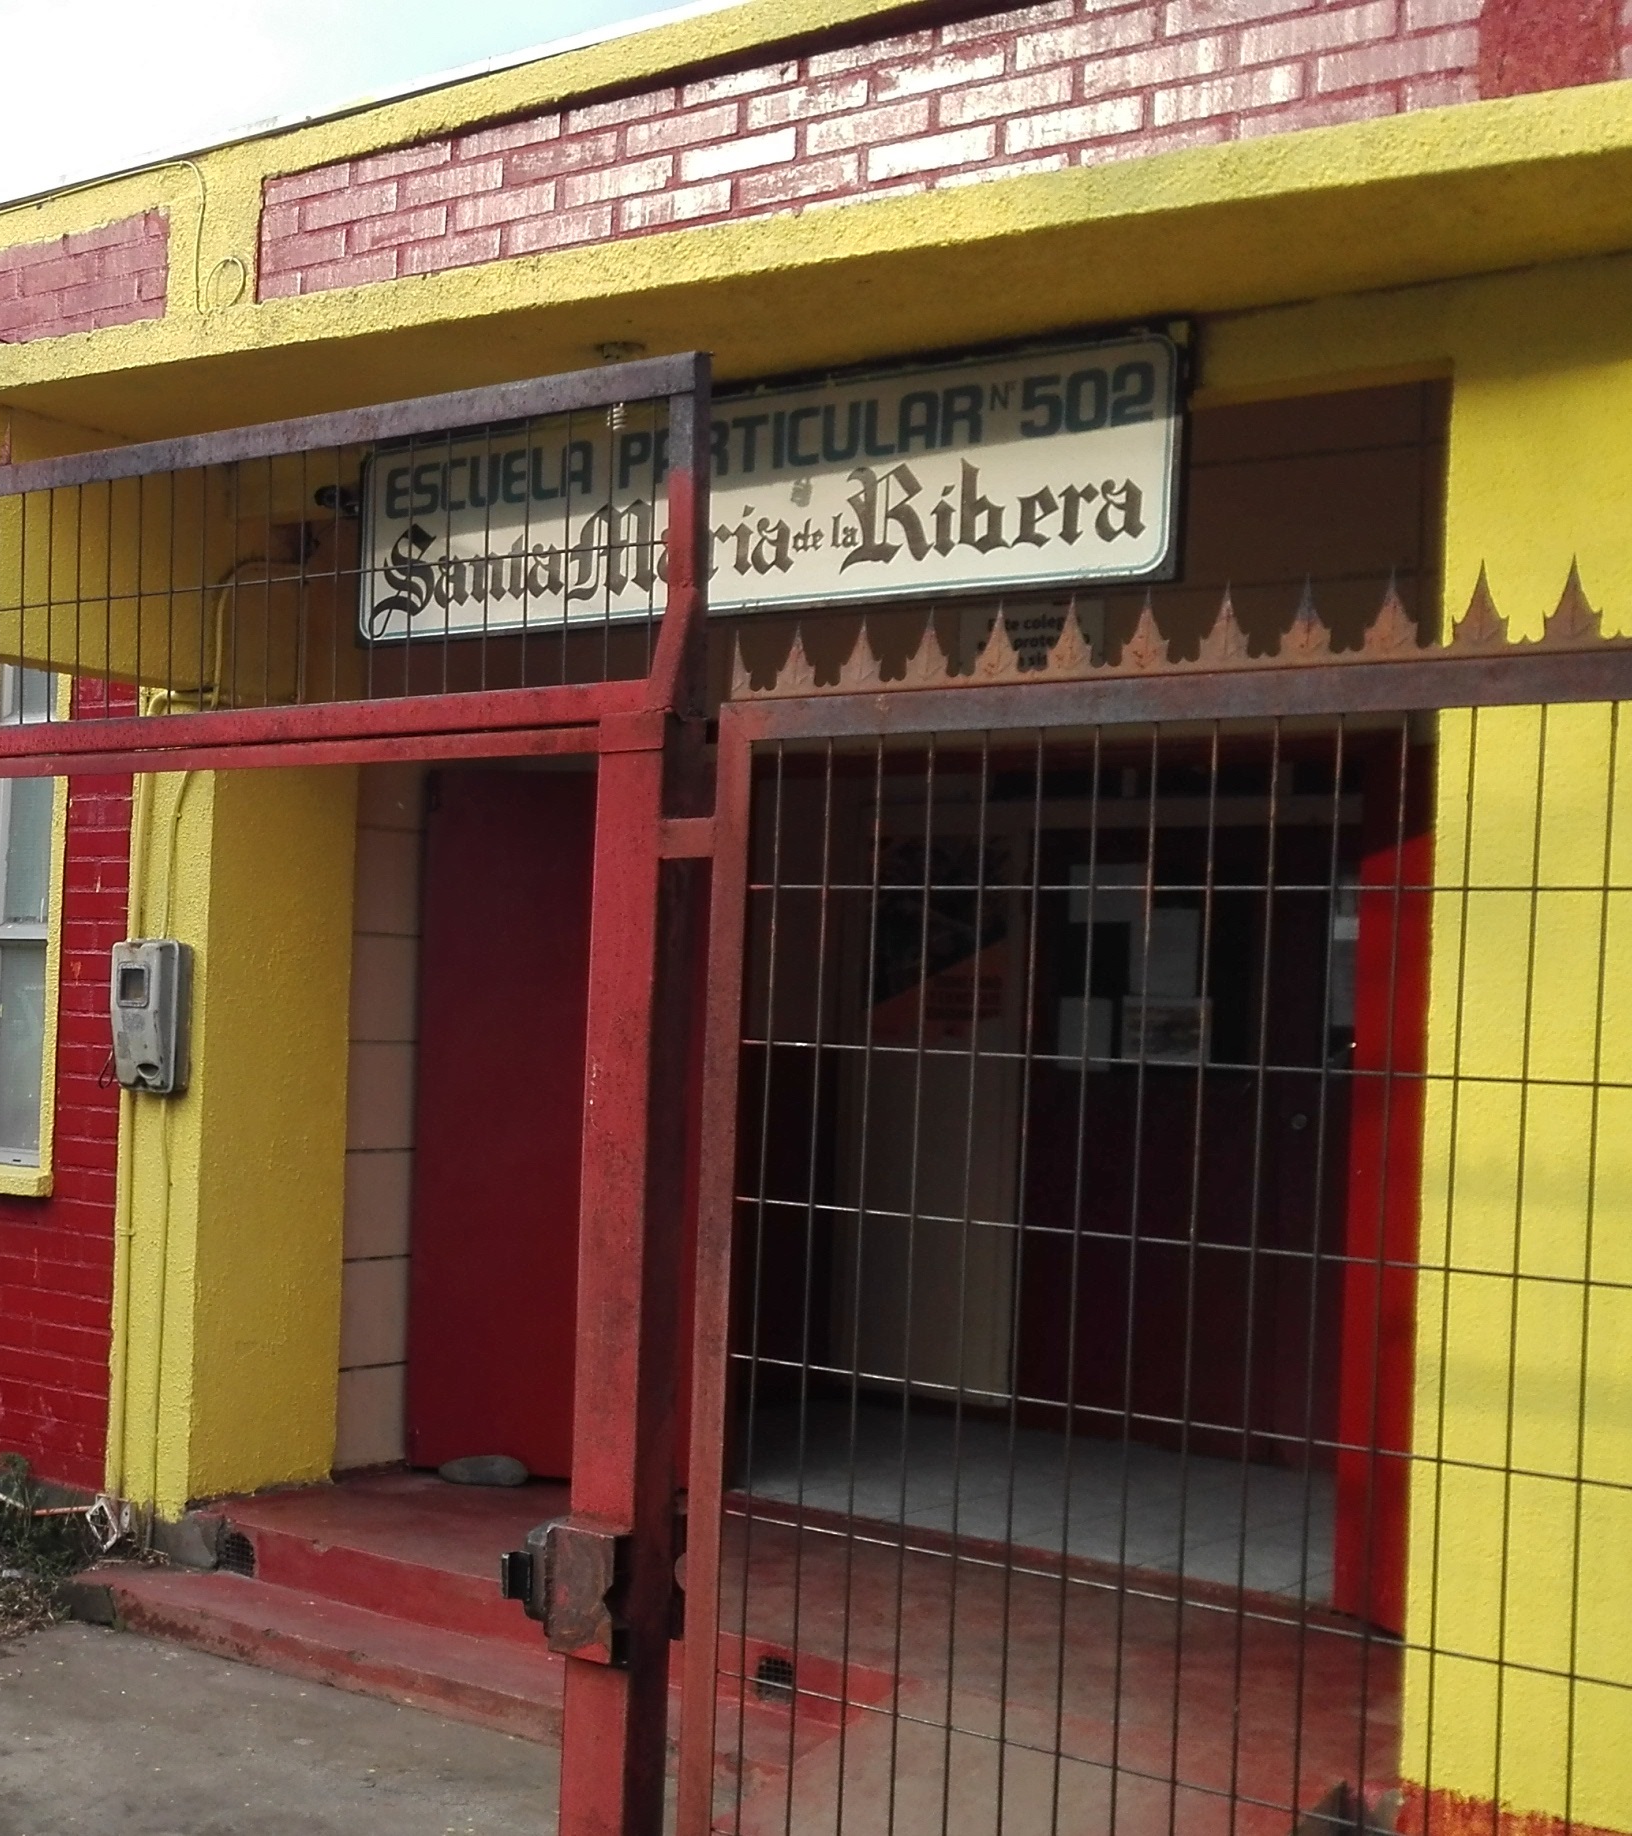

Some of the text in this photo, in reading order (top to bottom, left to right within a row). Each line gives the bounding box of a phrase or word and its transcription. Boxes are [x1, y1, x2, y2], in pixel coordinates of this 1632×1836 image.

[385, 440, 593, 519] ESCUELA
[1020, 361, 1155, 438] 502
[368, 457, 1147, 639] Santa Mria de la Ribera
